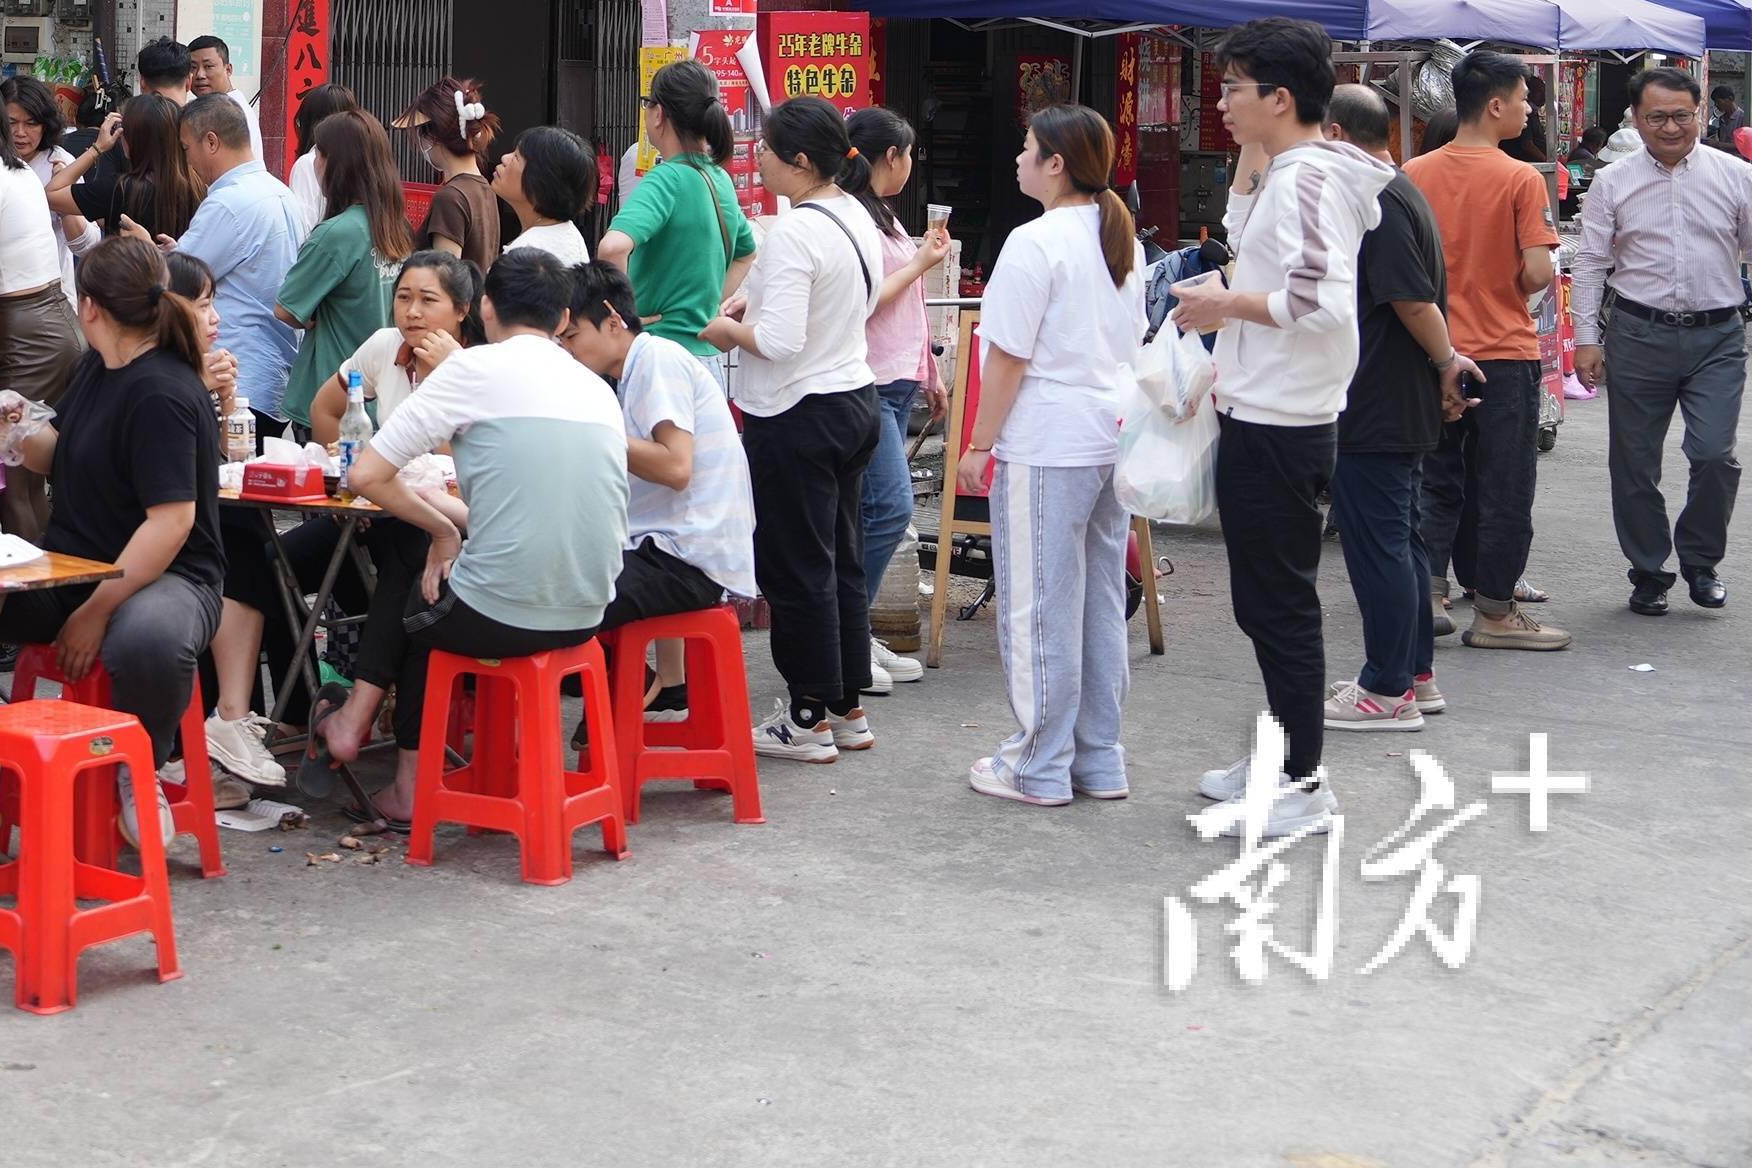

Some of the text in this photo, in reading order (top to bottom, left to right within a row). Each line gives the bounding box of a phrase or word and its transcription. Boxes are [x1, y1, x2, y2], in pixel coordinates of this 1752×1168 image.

[778, 33, 862, 57] 25年老牌牛杂
[787, 68, 854, 96] 特色牛杂
